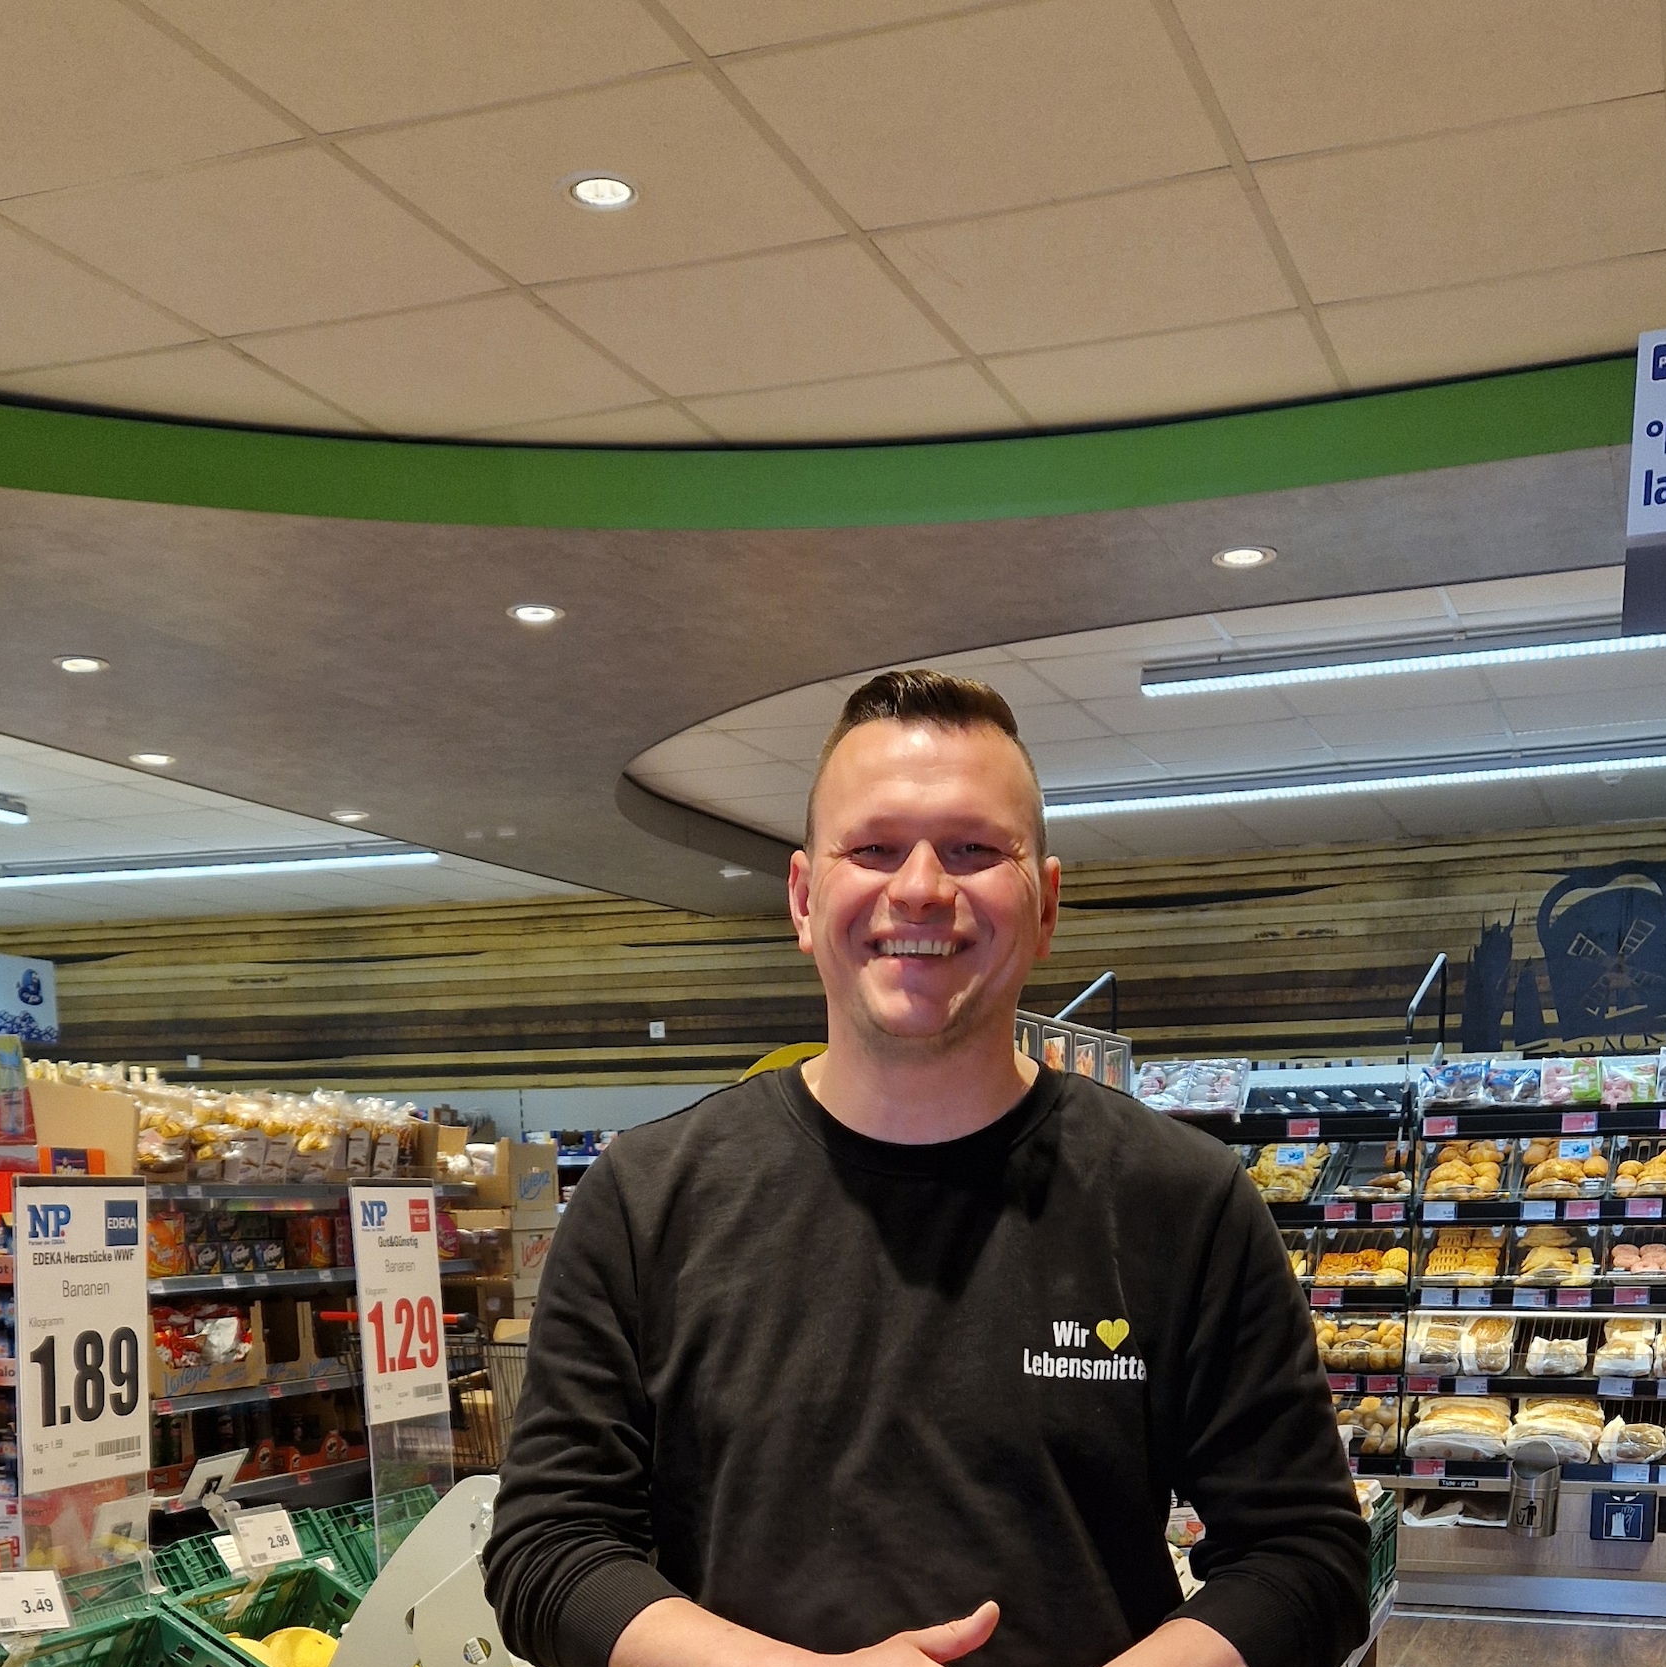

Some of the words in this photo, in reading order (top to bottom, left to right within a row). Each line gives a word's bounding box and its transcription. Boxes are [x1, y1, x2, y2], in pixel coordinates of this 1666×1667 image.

[106, 1217, 137, 1229] EDEKA
[377, 1235, 419, 1248] Gut&Günstig
[33, 1252, 63, 1266] EDEKA
[63, 1250, 113, 1264] Herzstücke
[114, 1248, 136, 1261] WWF
[385, 1258, 416, 1273] Bananen
[62, 1279, 111, 1298] Bananen
[28, 1316, 65, 1330] Kilogramm
[367, 1295, 440, 1374] 1.29
[1052, 1320, 1091, 1348] Wir
[1023, 1347, 1148, 1382] Lebensmitte
[29, 1326, 139, 1428] 1.89
[32, 1442, 44, 1454] 1kg
[50, 1438, 63, 1450] 1.89
[267, 1533, 290, 1549] 2.99
[21, 1598, 54, 1614] 3.49
